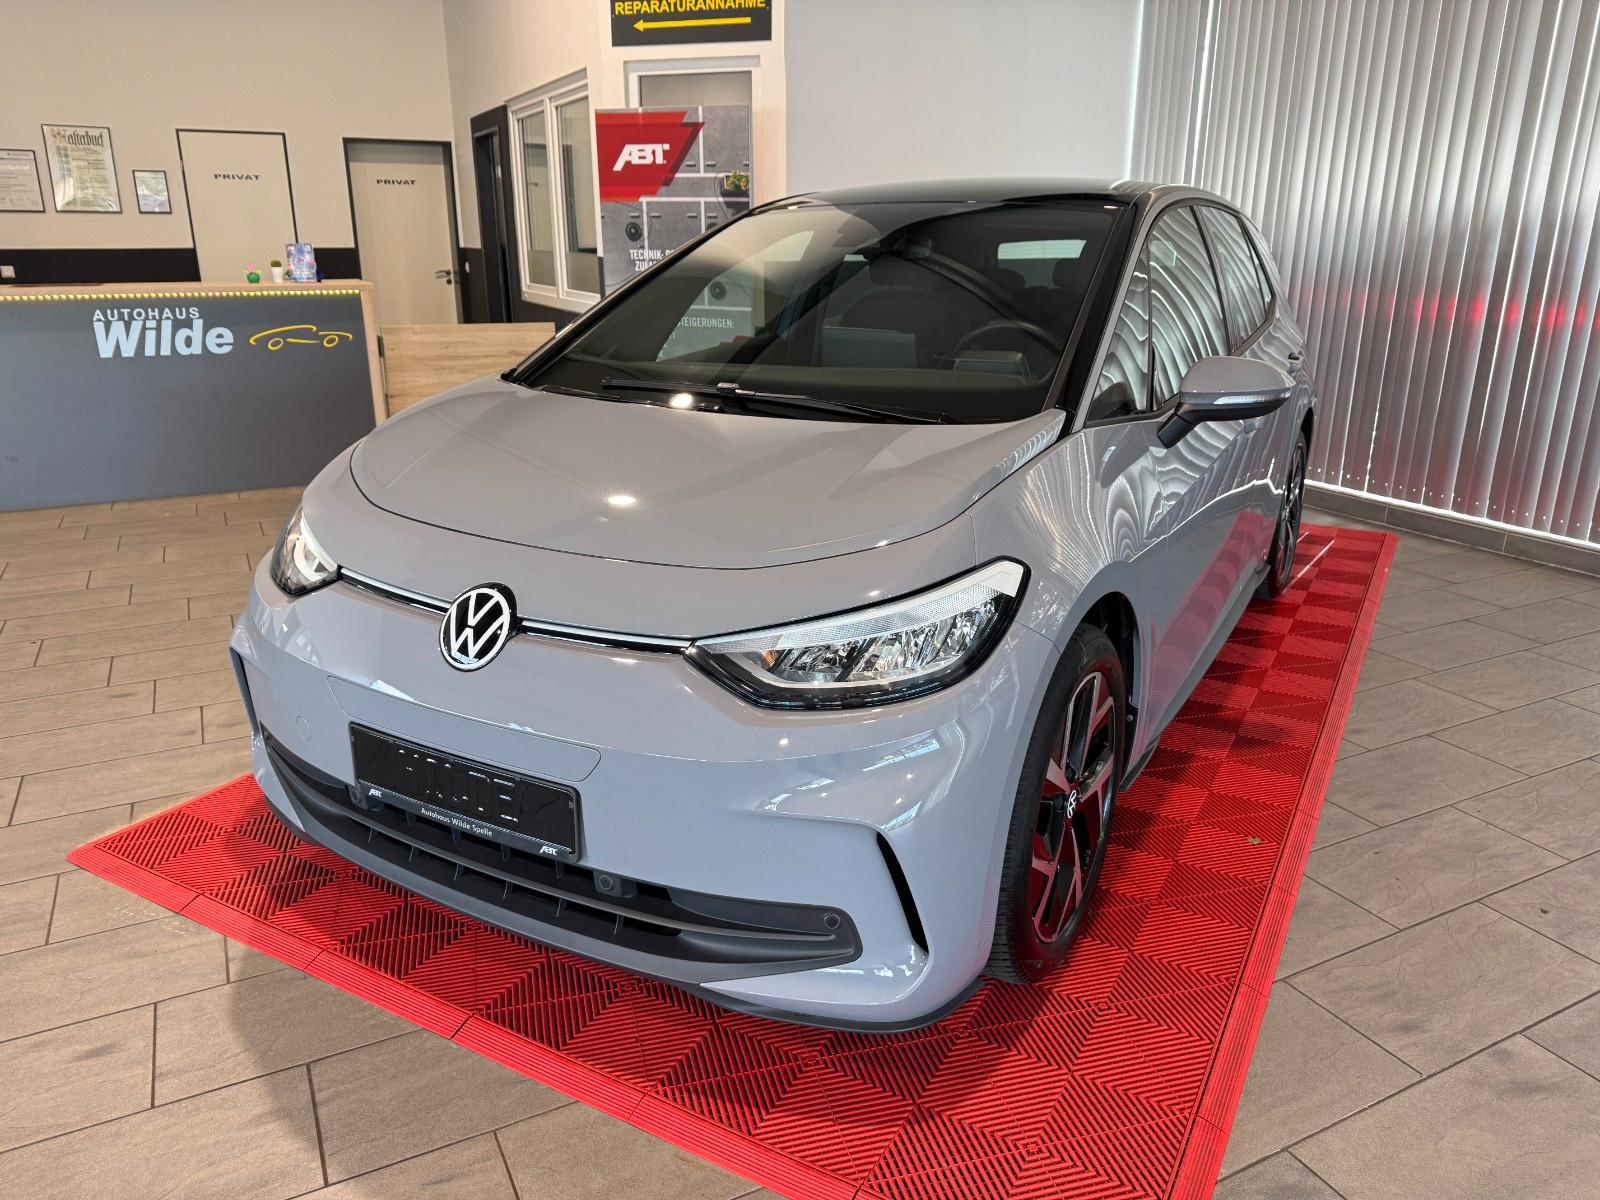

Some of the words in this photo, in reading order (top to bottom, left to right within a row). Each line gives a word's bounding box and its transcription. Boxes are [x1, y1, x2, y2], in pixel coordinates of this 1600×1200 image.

[614, 0, 766, 15] REPARATURANNAHME
[612, 144, 670, 171] ABT
[213, 173, 261, 181] PRIVAT
[93, 307, 200, 321] AUTOHAUS
[93, 318, 234, 358] Wilde
[368, 788, 383, 798] ABT
[421, 807, 450, 823] Autohaus
[451, 817, 471, 830] Wilde
[539, 845, 558, 856] ABT
